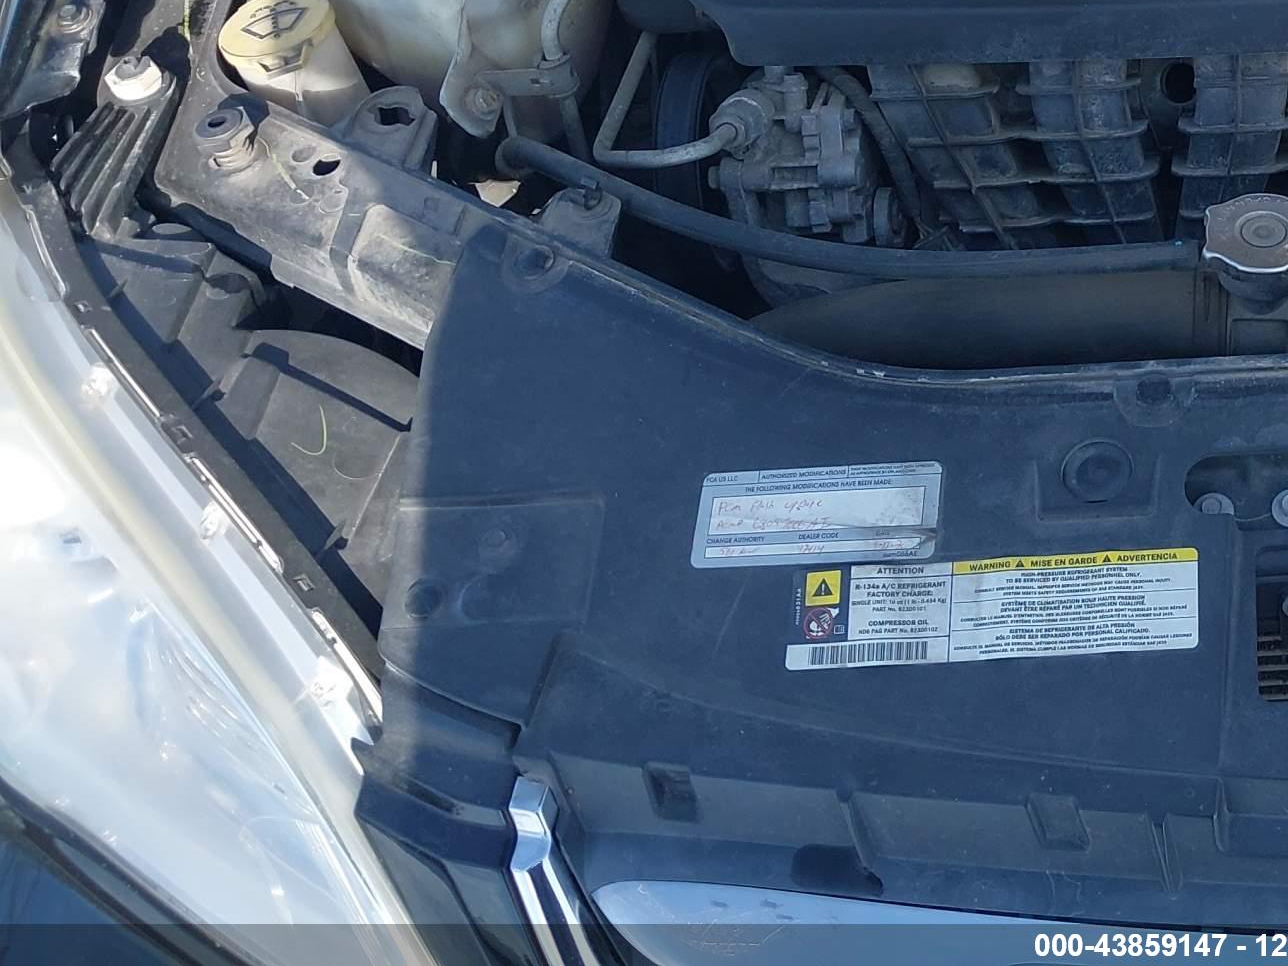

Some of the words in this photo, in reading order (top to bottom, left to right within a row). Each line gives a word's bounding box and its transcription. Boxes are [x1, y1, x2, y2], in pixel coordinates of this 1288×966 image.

[793, 482, 839, 490] MODIFICATIONS
[970, 561, 1011, 571] WARNING
[1117, 553, 1178, 562] ADVERTENCIA
[898, 581, 946, 589] REFRIGERANT
